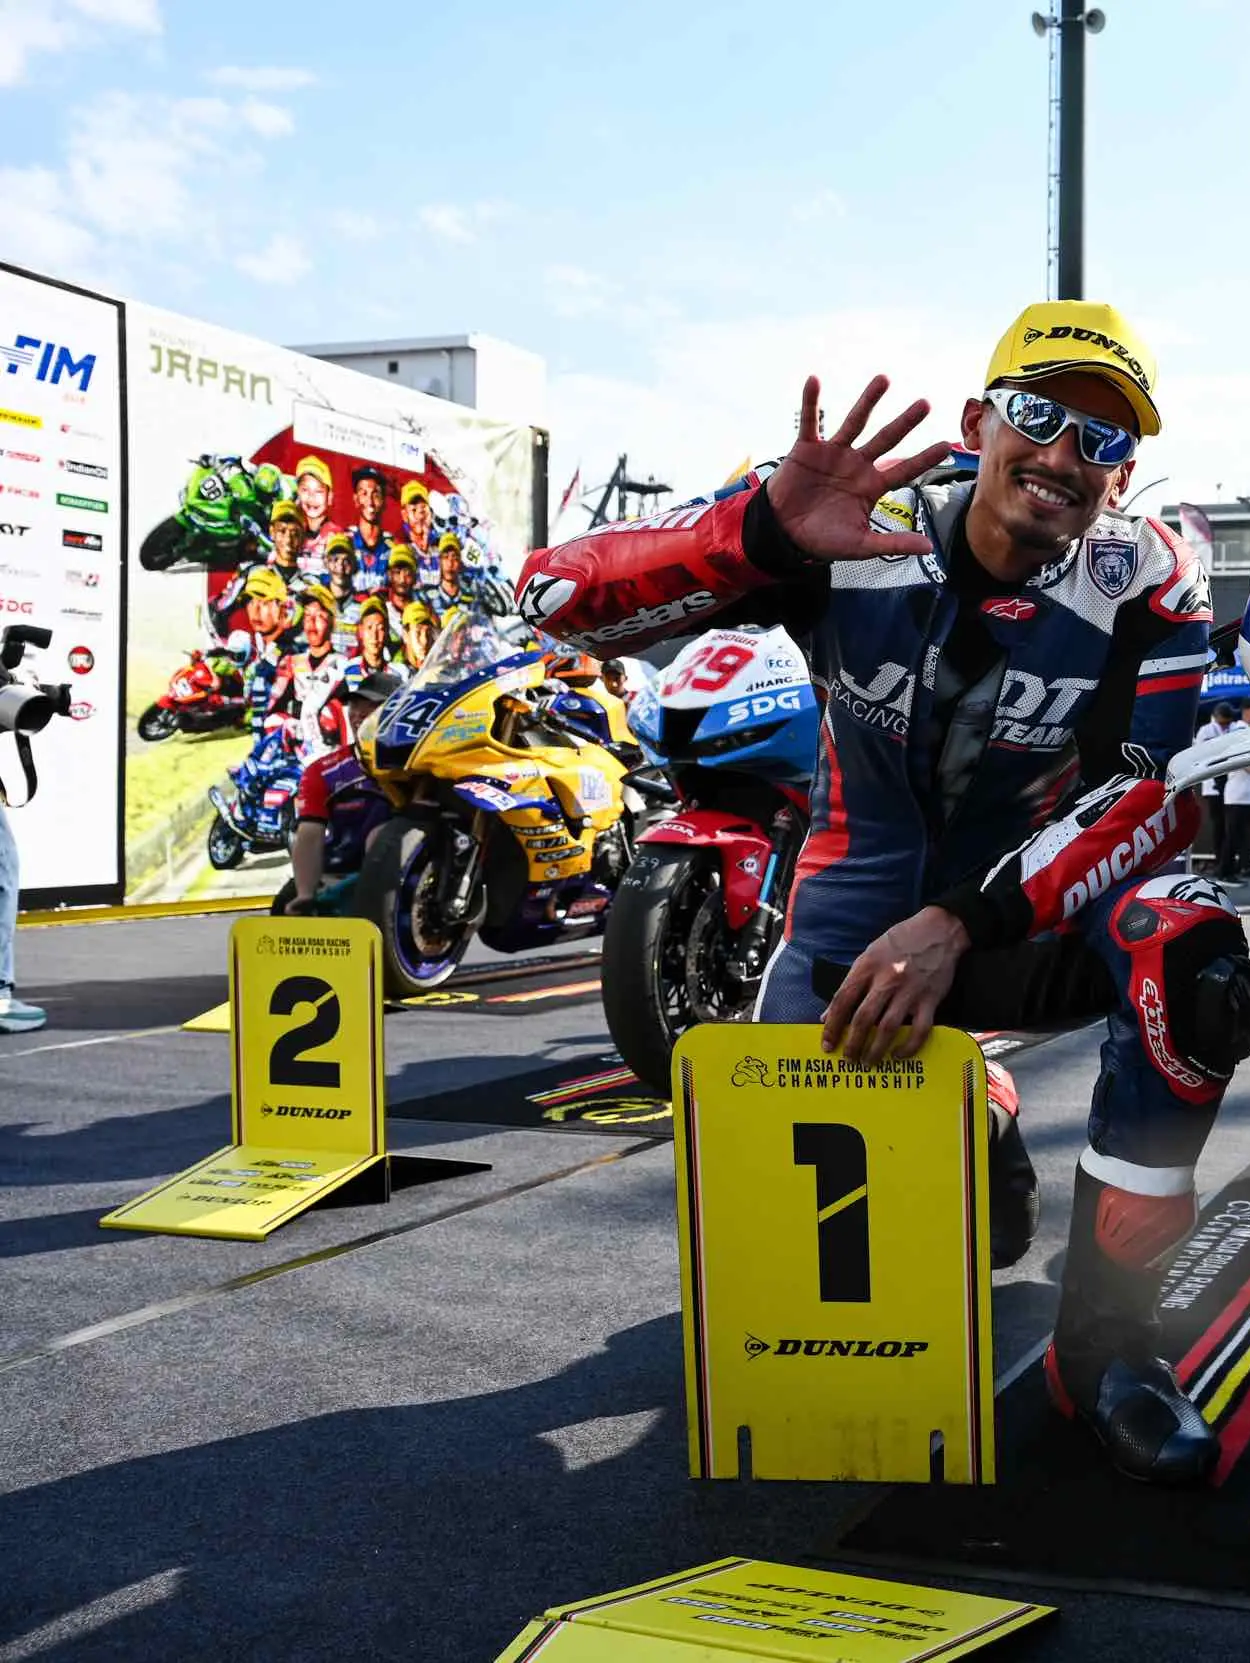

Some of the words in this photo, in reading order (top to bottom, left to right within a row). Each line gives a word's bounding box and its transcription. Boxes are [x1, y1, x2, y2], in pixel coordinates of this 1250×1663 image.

[0, 334, 97, 392] FIM
[149, 344, 273, 405] JAPAN
[661, 645, 757, 693] 39
[727, 690, 801, 726] SDG
[830, 679, 910, 736] RACING
[989, 718, 1077, 746] TEAM
[1062, 801, 1178, 921] DUCATI
[279, 945, 351, 956] CHAMPIONSHIP
[326, 938, 351, 948] RACING
[269, 975, 342, 1089] 2
[778, 1058, 801, 1073] FIM
[805, 1058, 833, 1073] ASIA
[877, 1059, 924, 1074] RACING
[778, 1074, 925, 1089] CHAMPIONSHIP
[275, 1104, 353, 1120] DUNLOP
[792, 1122, 872, 1303] 1
[1160, 1220, 1232, 1298] CHAMPION
[1214, 1237, 1249, 1254] ASIA
[1193, 1253, 1234, 1275] ROAD
[1160, 1276, 1214, 1309] RACING
[773, 1339, 929, 1358] DUNLOP
